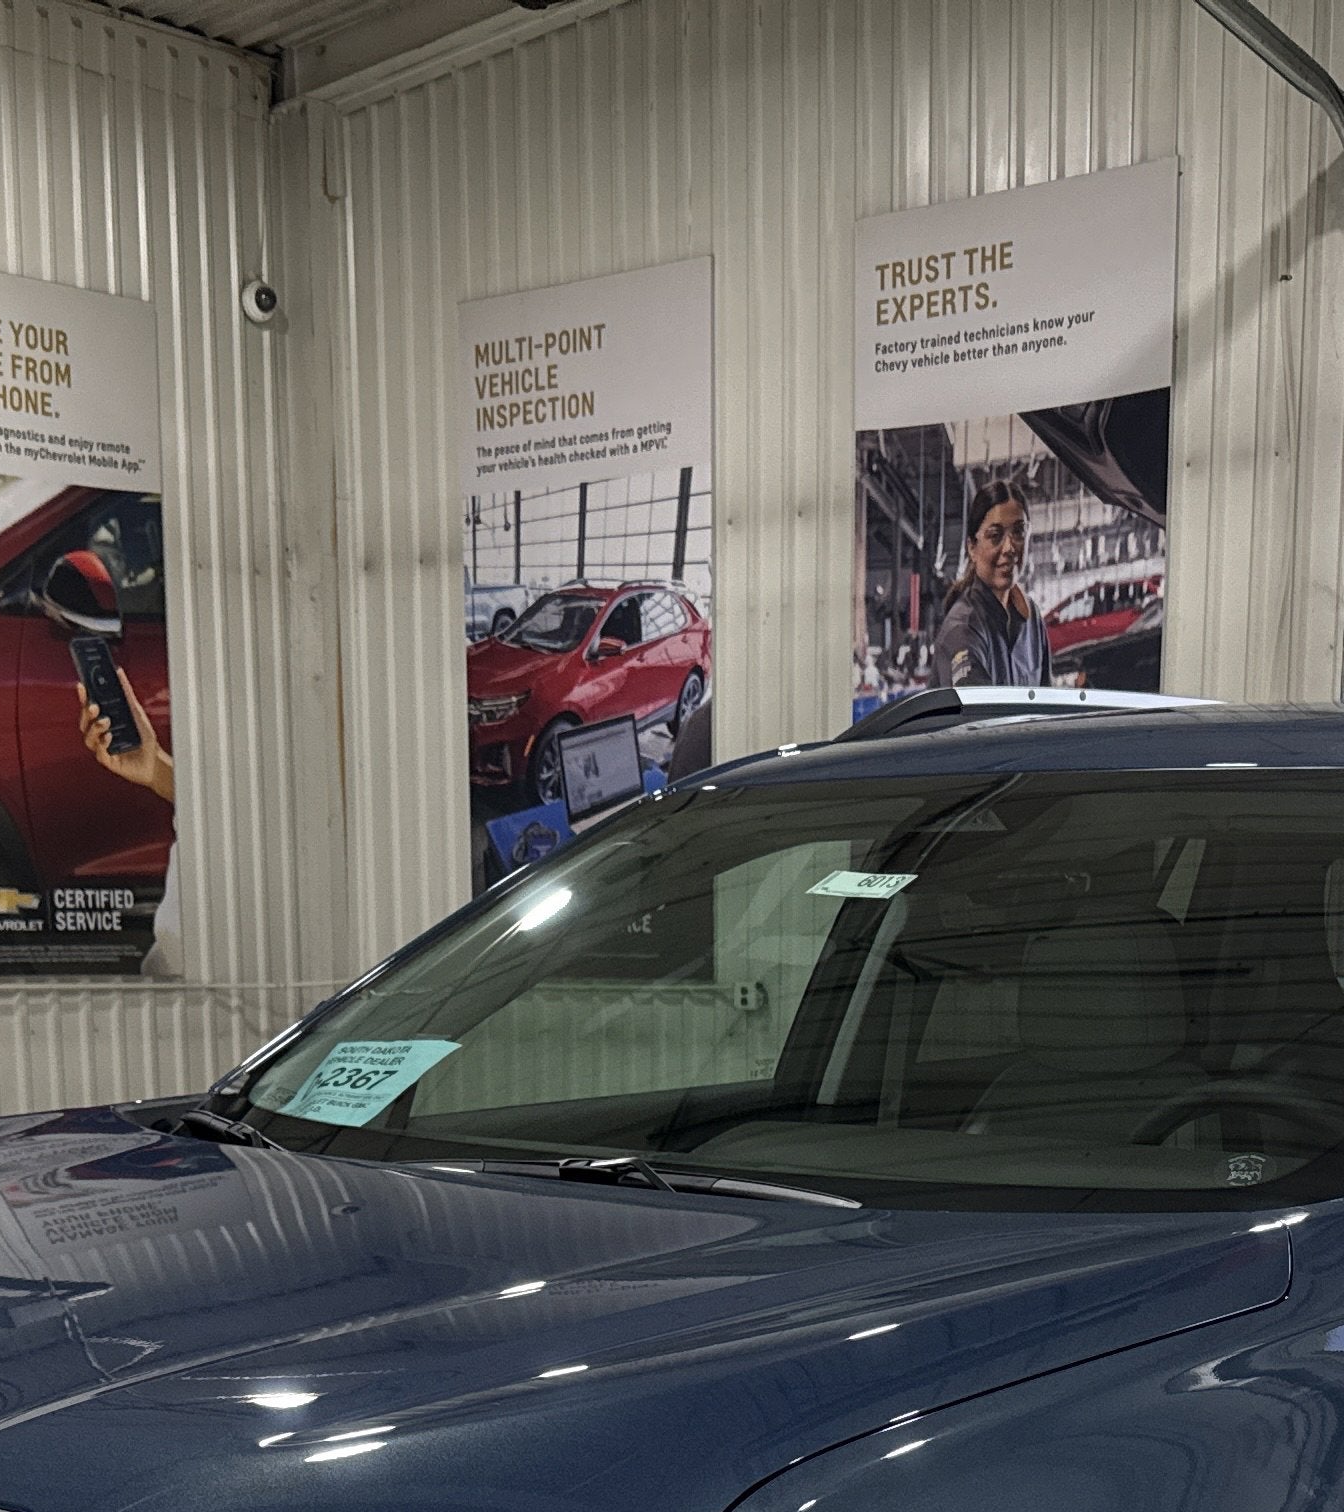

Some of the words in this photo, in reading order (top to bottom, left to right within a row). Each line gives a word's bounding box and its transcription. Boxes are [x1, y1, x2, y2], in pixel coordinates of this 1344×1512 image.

[875, 251, 956, 291] TRUST
[963, 240, 1014, 276] THE
[875, 282, 998, 327] EXPERTS.
[9, 320, 69, 356] YOUR
[474, 323, 606, 369] MULTI-POINT
[874, 338, 917, 356] Factory
[920, 331, 961, 349] trained
[963, 320, 1030, 344] technicians
[1033, 314, 1065, 333] know
[1067, 310, 1096, 329] your
[11, 354, 72, 388] FROM
[874, 356, 909, 374] Chevy
[911, 352, 950, 370] vehicle
[953, 346, 988, 364] better
[992, 340, 1019, 359] than
[1021, 334, 1067, 354] anyone.
[475, 364, 559, 400] VEHICLE
[476, 391, 595, 432] INSPECTION
[5, 442, 21, 456] the
[24, 446, 86, 466] myChevrolet
[89, 455, 118, 470] Mobile
[48, 432, 66, 446] and
[68, 436, 94, 453] enjoy
[96, 441, 130, 455] remote
[476, 445, 492, 459] The
[494, 443, 520, 458] peace
[522, 440, 532, 453] of
[533, 438, 556, 451] mind
[558, 435, 577, 448] that
[579, 430, 609, 446] comes
[611, 426, 635, 441] from
[637, 420, 672, 439] getting
[476, 461, 496, 477] your
[498, 454, 536, 472] vehicle's
[538, 451, 567, 467] health
[568, 446, 607, 464] checked
[609, 443, 630, 458] with
[54, 888, 135, 909] CERTIFIED
[56, 911, 122, 931] SERVICE
